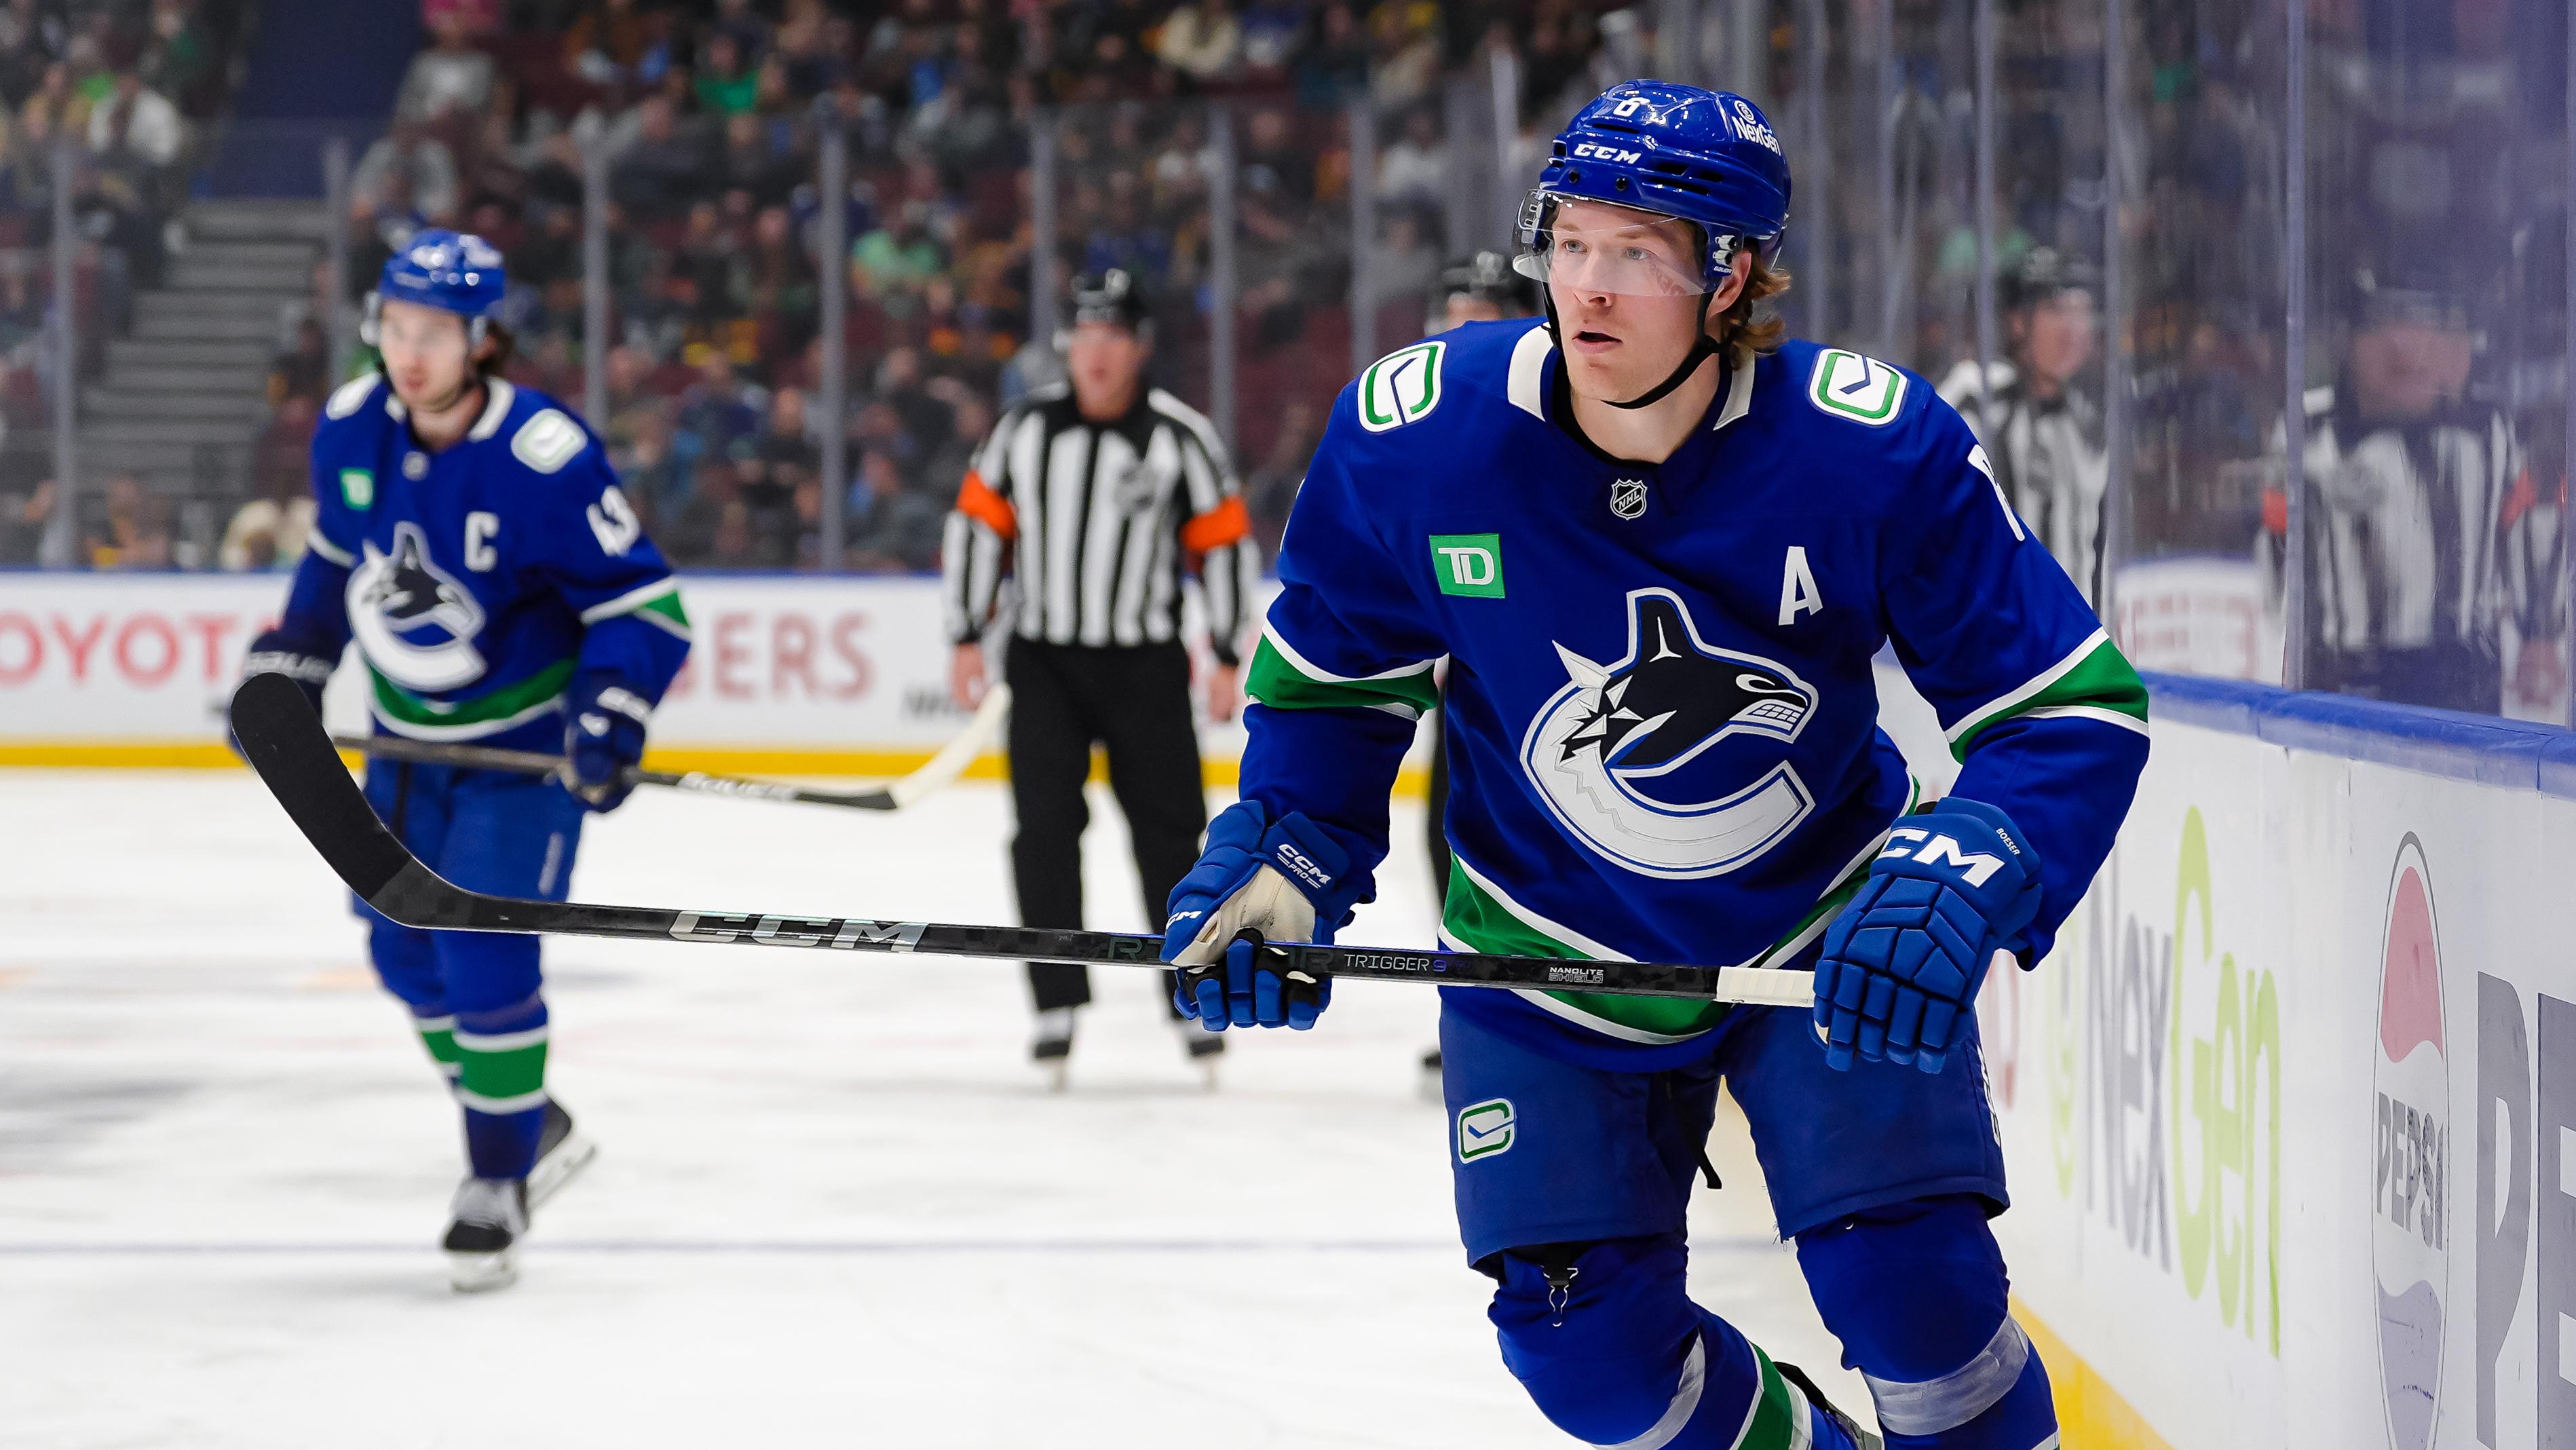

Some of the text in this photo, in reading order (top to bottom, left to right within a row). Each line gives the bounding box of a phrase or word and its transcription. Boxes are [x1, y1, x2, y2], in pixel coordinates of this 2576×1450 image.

[1574, 143, 1642, 164] CCM
[1731, 116, 1781, 156] NexGen
[1618, 491, 1640, 510] NHL
[586, 484, 640, 557] 43
[465, 511, 500, 573] C
[1438, 548, 1494, 585] TD
[1779, 546, 1823, 626] A
[0, 611, 282, 691] OYOT
[1996, 828, 2020, 856] BOESER
[1278, 844, 1331, 885] CCM
[1287, 864, 1309, 879] PRO
[669, 910, 930, 952] CCM
[1344, 954, 1430, 972] TRIGGER
[1433, 959, 1447, 972] 9
[1549, 973, 1604, 984] SHIELD
[1550, 967, 1604, 975] NANOLITE
[2377, 1092, 2443, 1251] PEPSI
